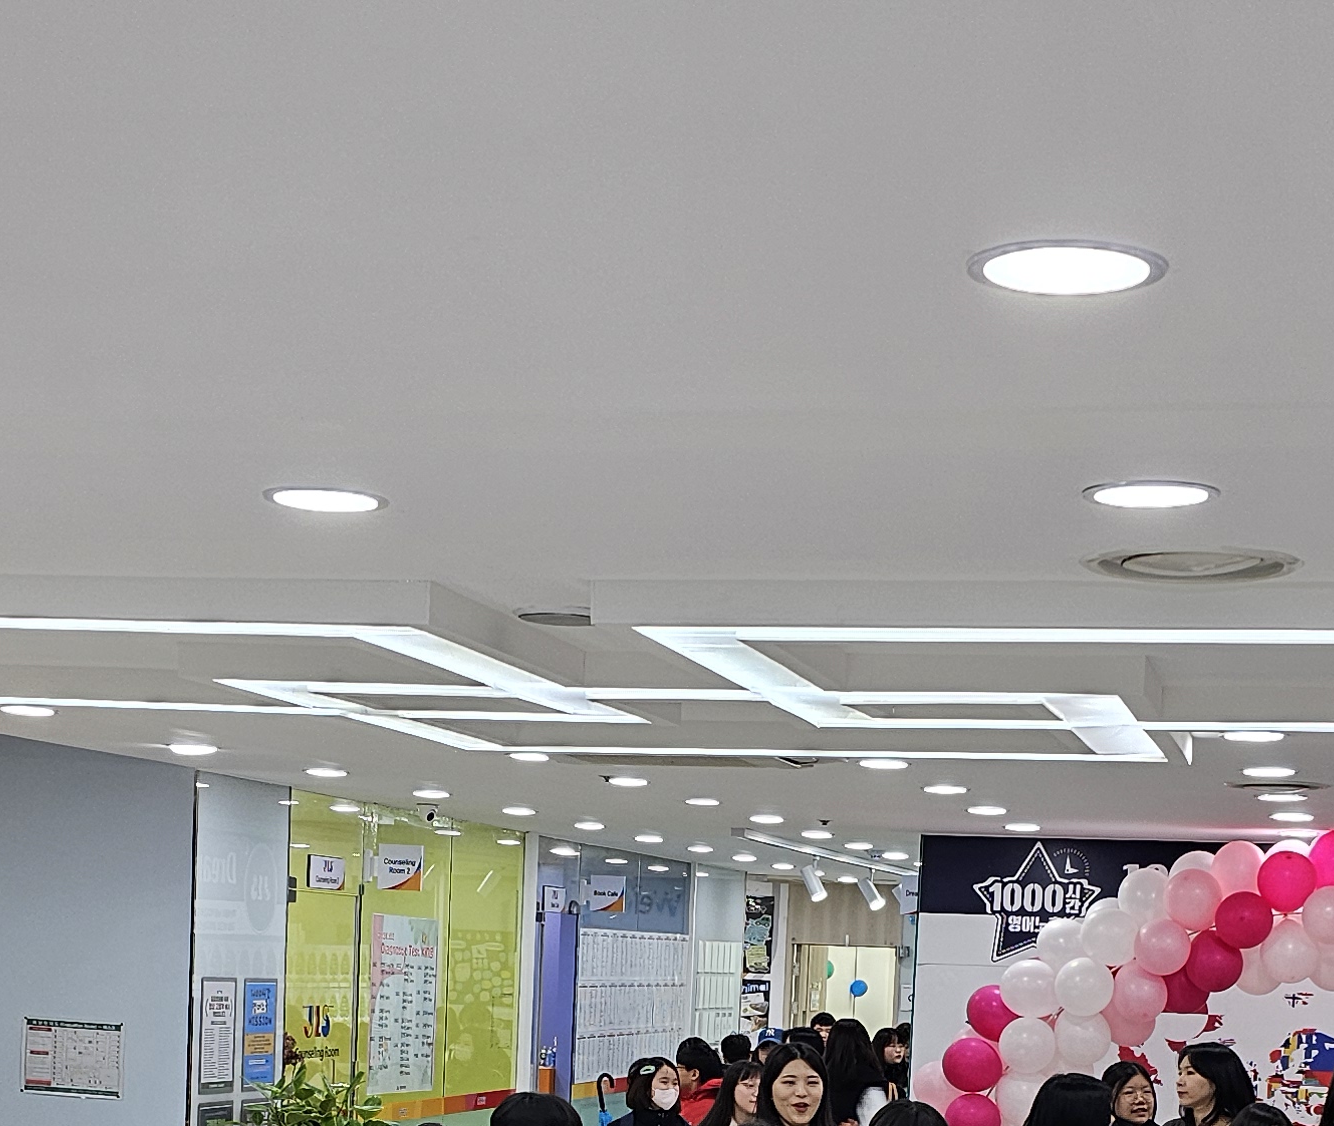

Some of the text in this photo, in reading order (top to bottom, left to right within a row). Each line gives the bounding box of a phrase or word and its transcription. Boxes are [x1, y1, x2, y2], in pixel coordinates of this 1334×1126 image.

[383, 858, 416, 867] Counseling
[388, 866, 411, 875] Room 2
[593, 889, 619, 898] Book Cafe
[302, 1005, 334, 1038] JLS
